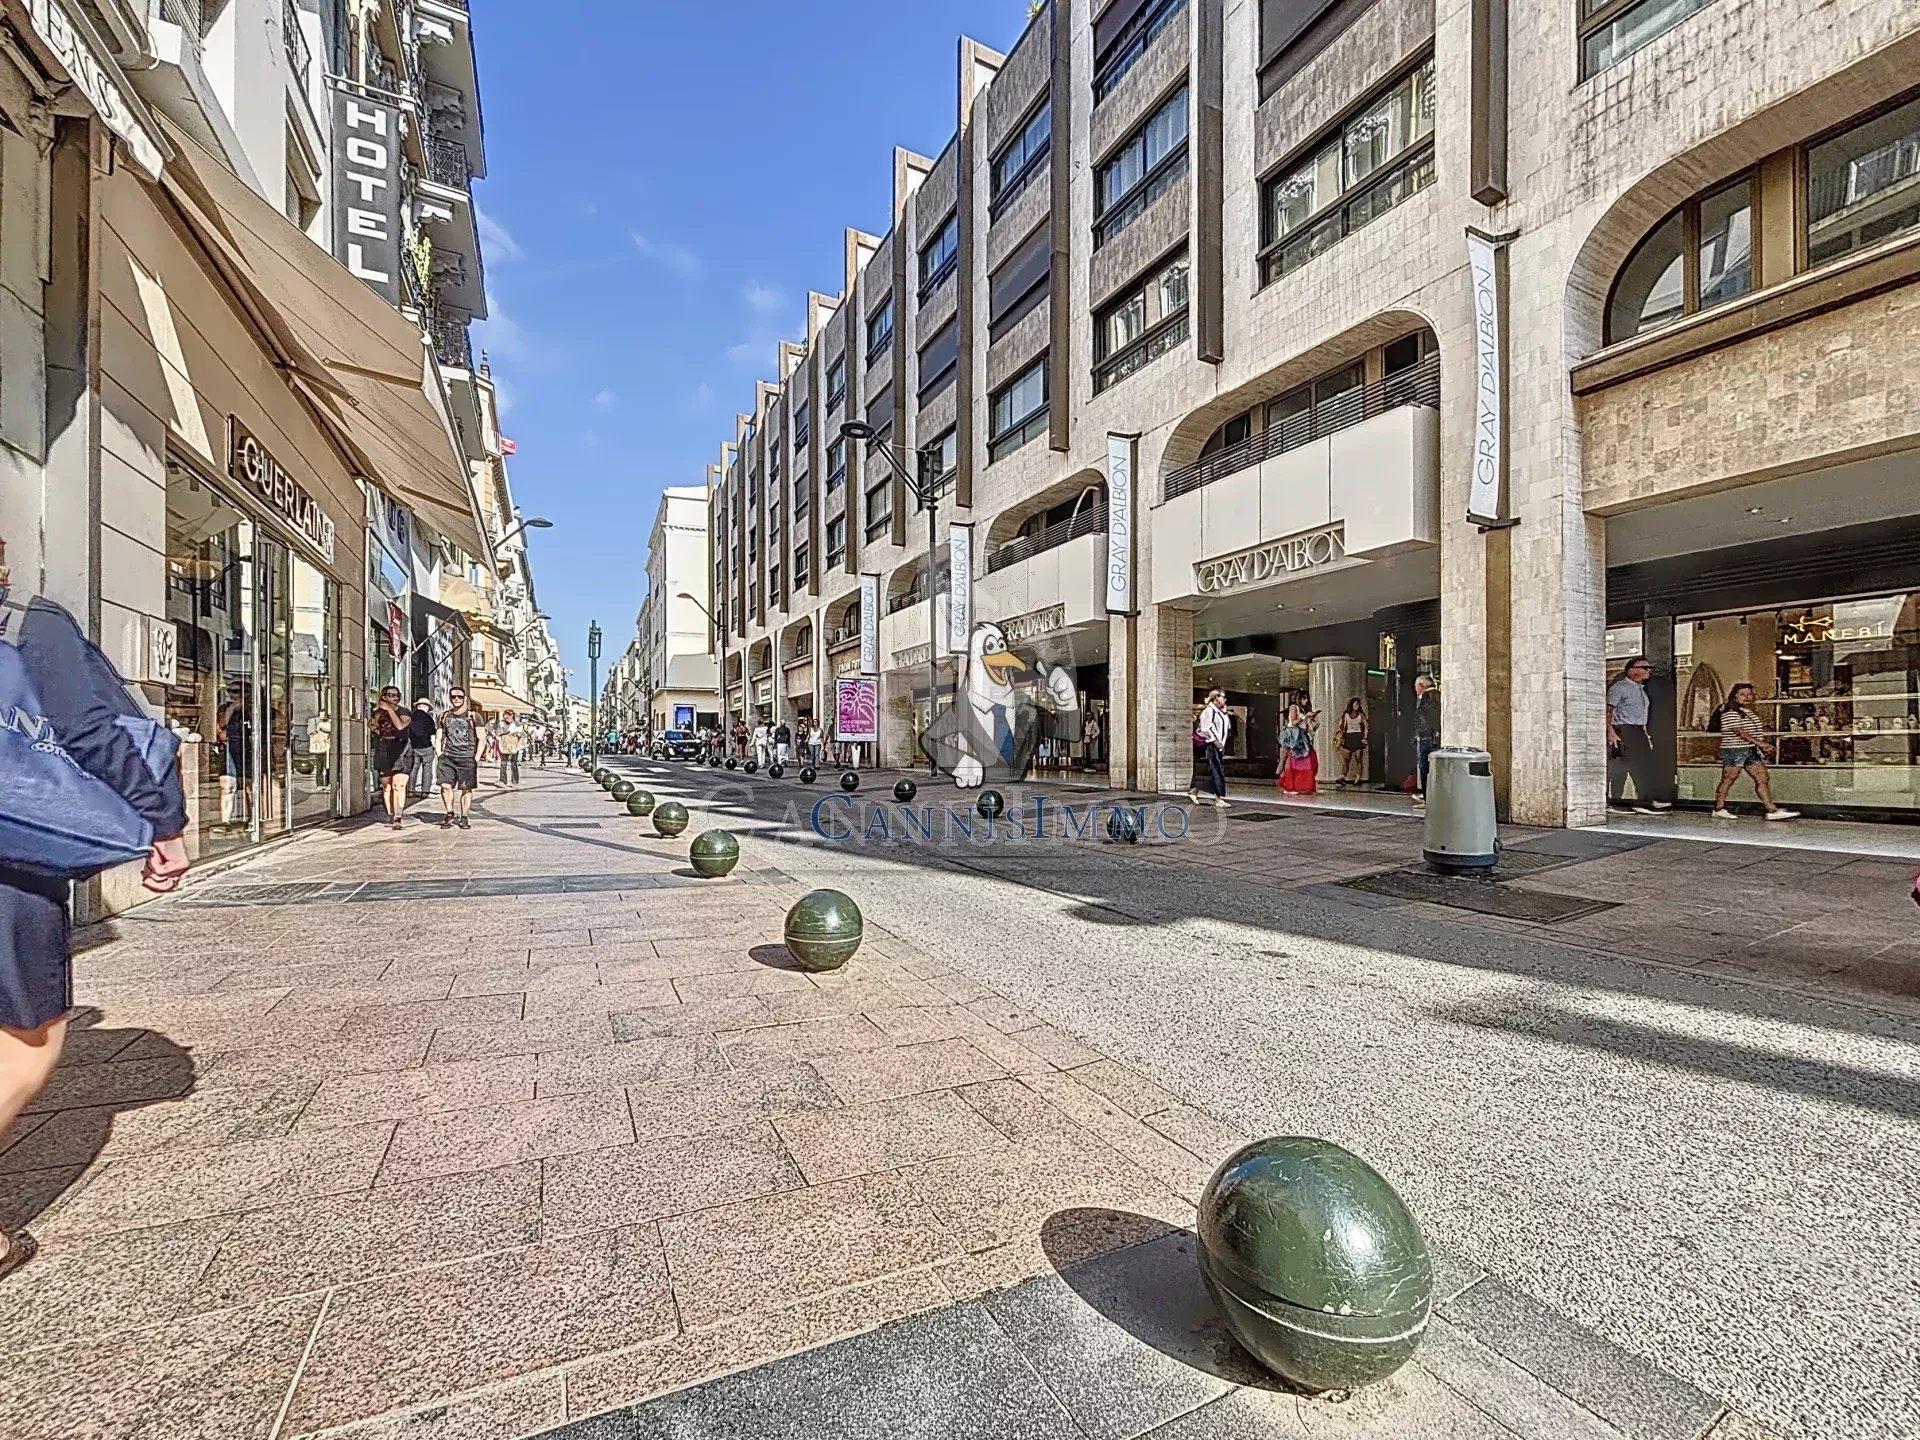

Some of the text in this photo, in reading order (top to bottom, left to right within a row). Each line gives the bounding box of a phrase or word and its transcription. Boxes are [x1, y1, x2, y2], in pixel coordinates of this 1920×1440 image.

[346, 99, 389, 284] HOTEL
[1475, 264, 1496, 486] GRAY D'ALBION
[237, 436, 326, 547] GUERLAIN
[1110, 455, 1127, 592] GRAY D'ALBION
[1197, 530, 1346, 593] GRAY D'ALBION
[863, 634, 875, 663] GRAY
[954, 600, 966, 637] GRAY
